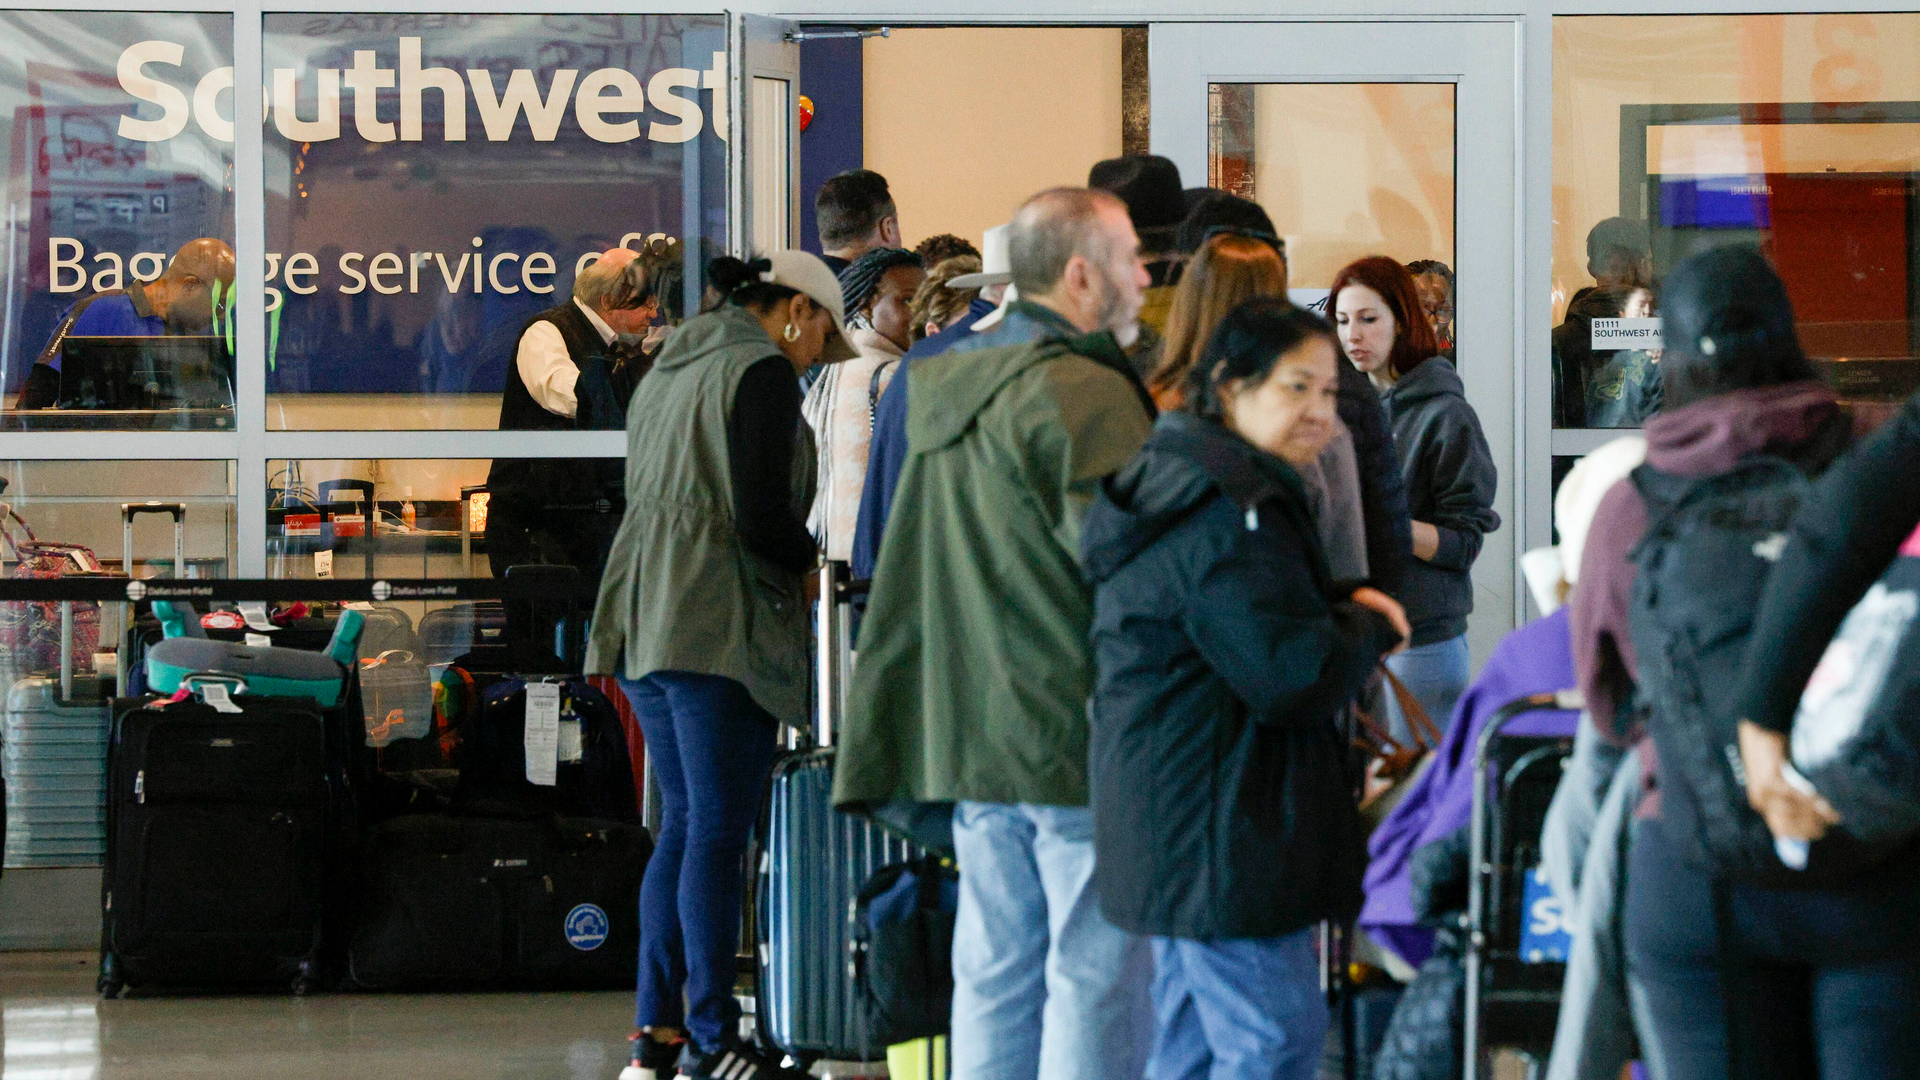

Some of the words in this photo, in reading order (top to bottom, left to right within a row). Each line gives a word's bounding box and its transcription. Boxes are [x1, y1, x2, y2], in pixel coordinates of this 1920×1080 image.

[338, 237, 557, 295] service
[1594, 320, 1619, 328] B1111
[1594, 329, 1650, 338] SOUTHWEST
